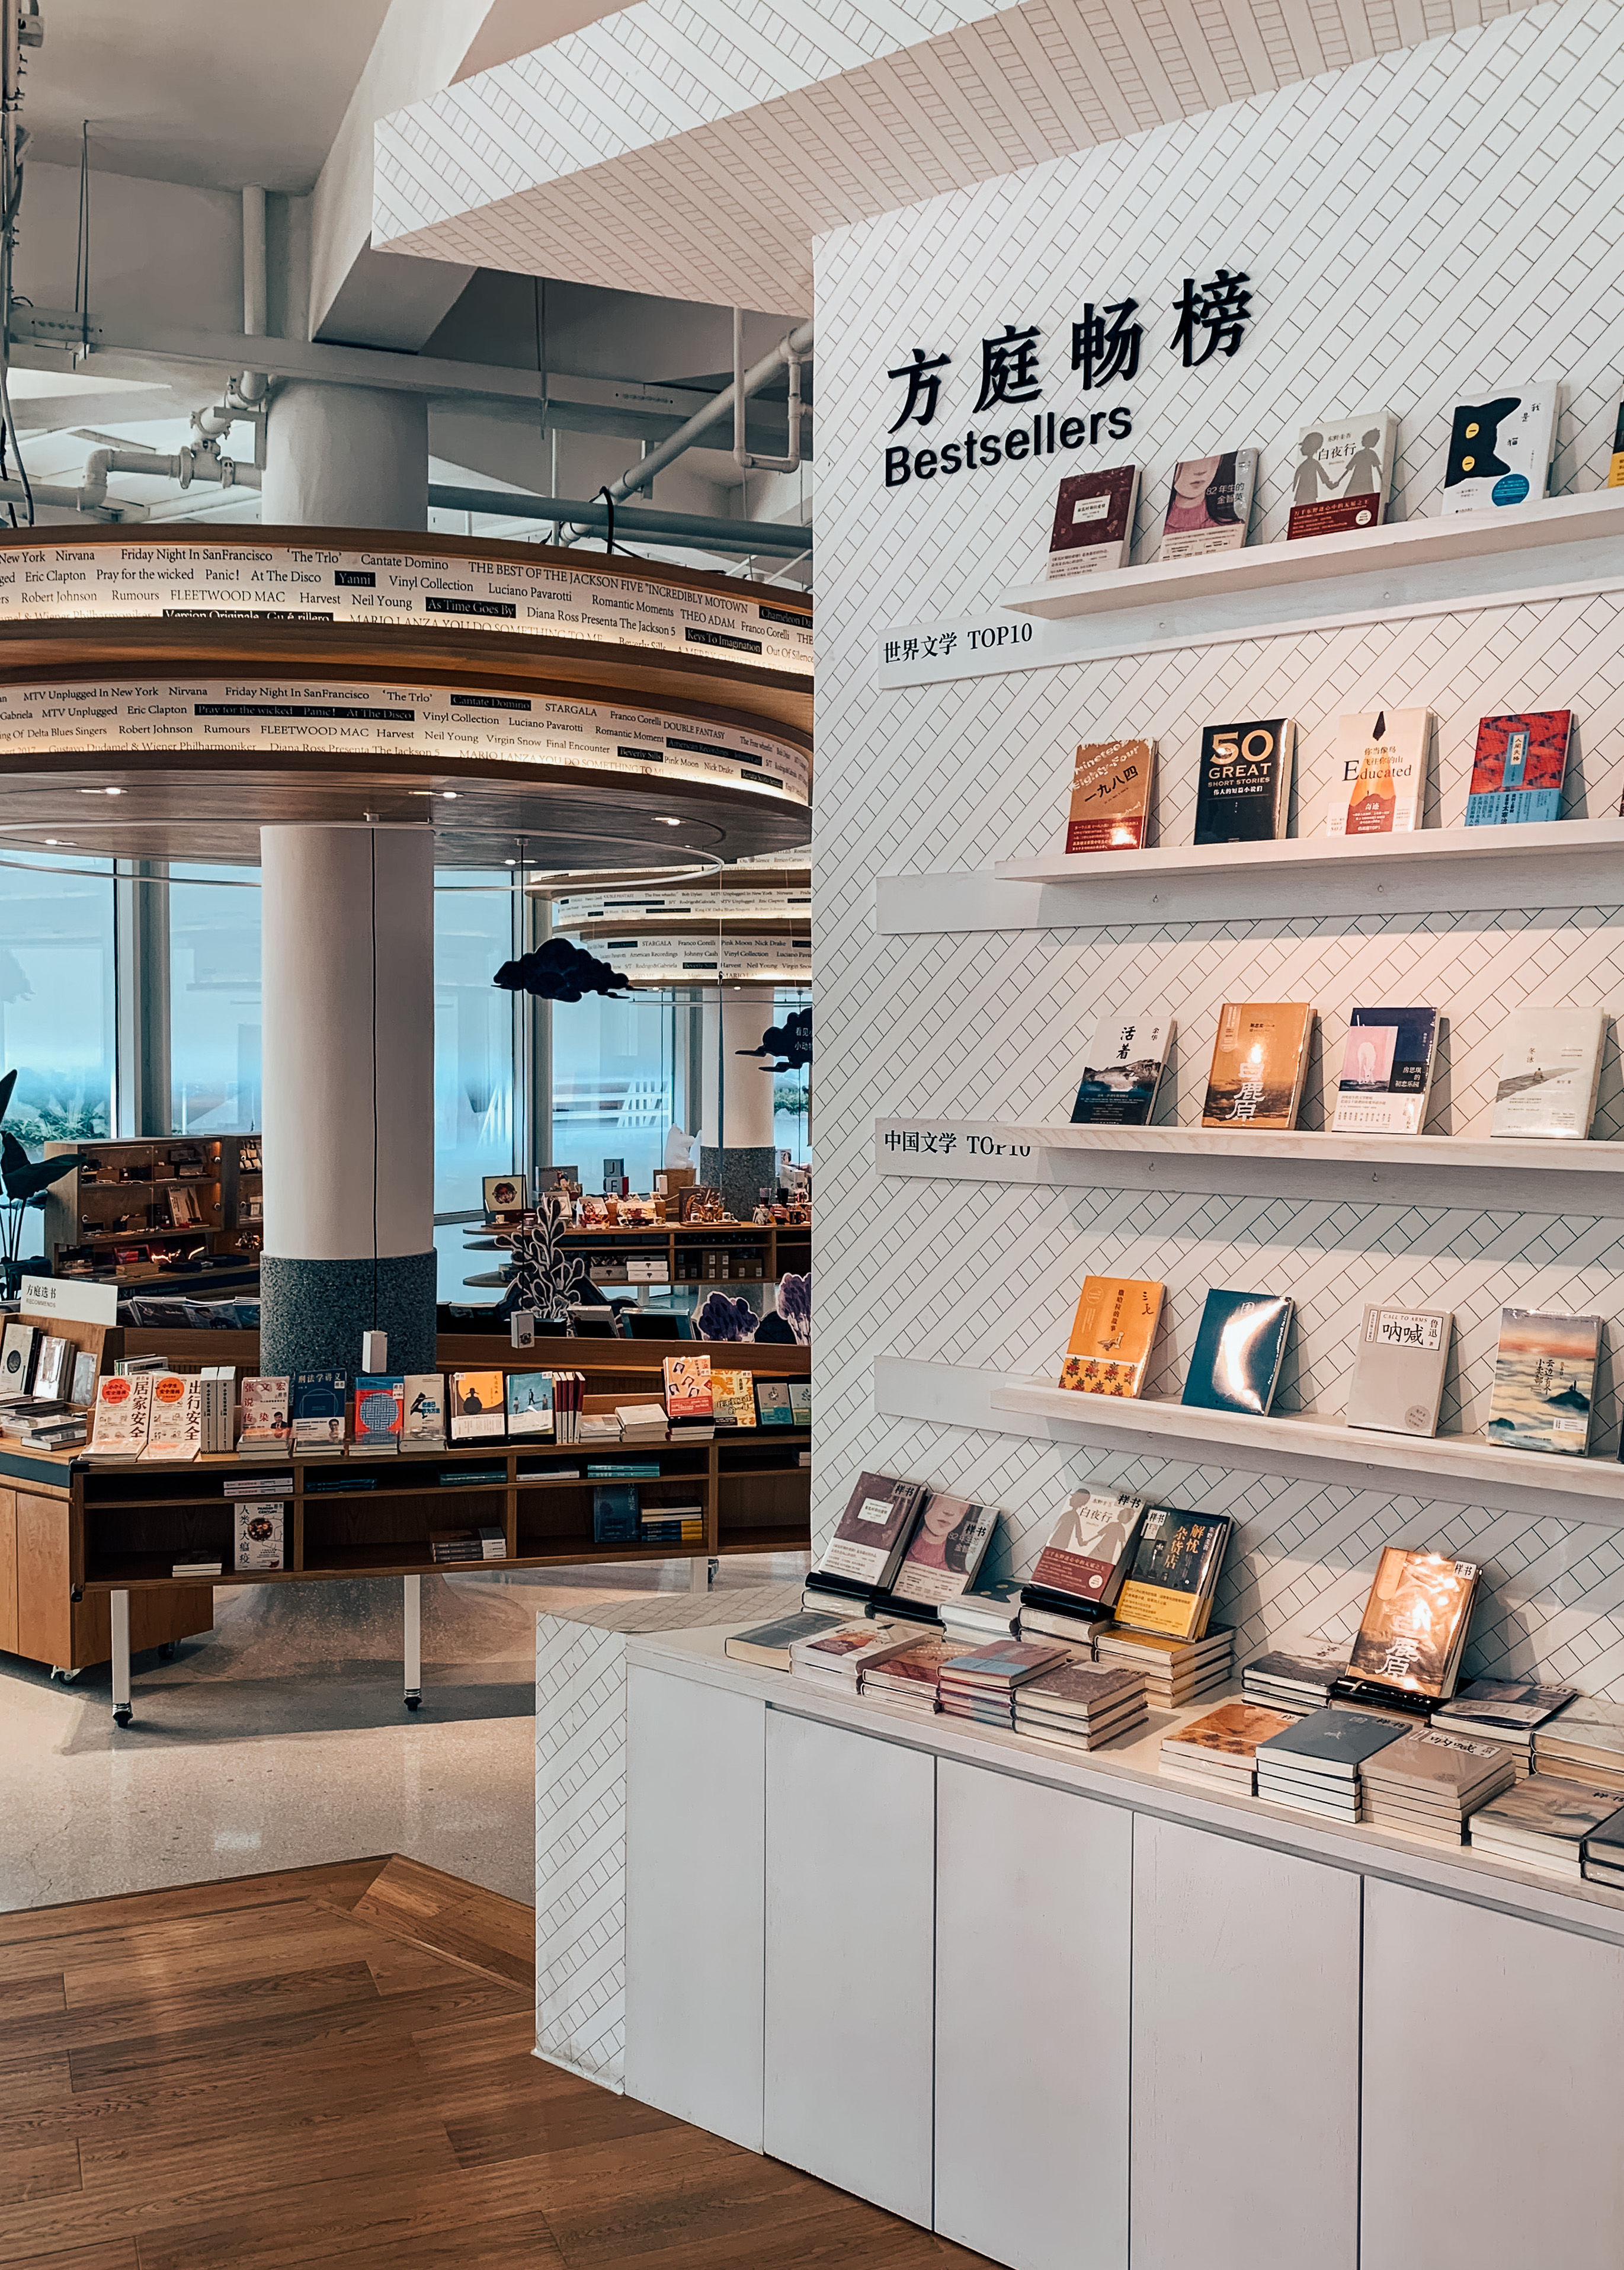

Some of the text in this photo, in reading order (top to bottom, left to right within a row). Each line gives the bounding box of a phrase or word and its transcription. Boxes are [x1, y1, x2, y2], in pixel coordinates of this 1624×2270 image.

[888, 270, 1252, 433] 方庭畅榜
[885, 406, 1132, 487] Bestsellers
[1318, 443, 1356, 460] 白夜行
[0, 549, 748, 613] New York Nirvana Friday Night In SanFrancisco Cantate Domino THE BEST OF THE JACKSON FIVE MOTOWN
[22, 590, 676, 636] Robert Johnson Rumours FLEETWOOD MAC Harvest Neil Young As Time Goes By Diana Ross The Jackson 5
[25, 568, 789, 641] Eric Clapton Pray for the wicked At The Disco Yanni Vinyl Collection Luciano Pavarotti Romantic Moments THEO ADAM Franco Corelli
[883, 623, 1032, 663] 世界文学 TOP10
[24, 687, 636, 722] MTV Unplugged In New York Nirvana Friday Night In SanFrancisco STARGALA Franco
[127, 705, 544, 729] Eric Clapton Vinyl Collection Luciano
[119, 725, 369, 737] Robert Johnson Rumours FLEETWOOD MAC
[1210, 730, 1274, 765] 50
[1207, 777, 1270, 788] SHORT STORIES
[1209, 763, 1271, 779] GREAT
[1343, 760, 1412, 782] Educated
[1085, 766, 1139, 803] 一九八四
[1116, 1026, 1136, 1059] 活着
[1225, 1063, 1266, 1120] 白鹿原
[885, 1130, 957, 1154] 中国文学
[609, 1162, 615, 1174] J
[26, 1285, 57, 1299] 方庭选书
[1382, 1321, 1424, 1346] 呐喊
[1428, 1319, 1439, 1338] 鲁迅
[244, 1382, 286, 1392] 张文宏
[299, 1373, 341, 1384] 刑法学讲义
[1544, 1359, 1555, 1395] 云边有个
[130, 1381, 148, 1438] 居家安全
[184, 1380, 201, 1440] 出行安全
[244, 1397, 254, 1407] 说
[244, 1413, 269, 1422] 传染
[895, 1484, 915, 1497] 样书
[1118, 1494, 1142, 1509] 样书
[1080, 1506, 1113, 1523] 白夜行
[1150, 1512, 1165, 1523] 样书
[965, 1523, 988, 1537] 样书
[1186, 1523, 1206, 1554] 解忧
[1454, 1563, 1473, 1576] 样书
